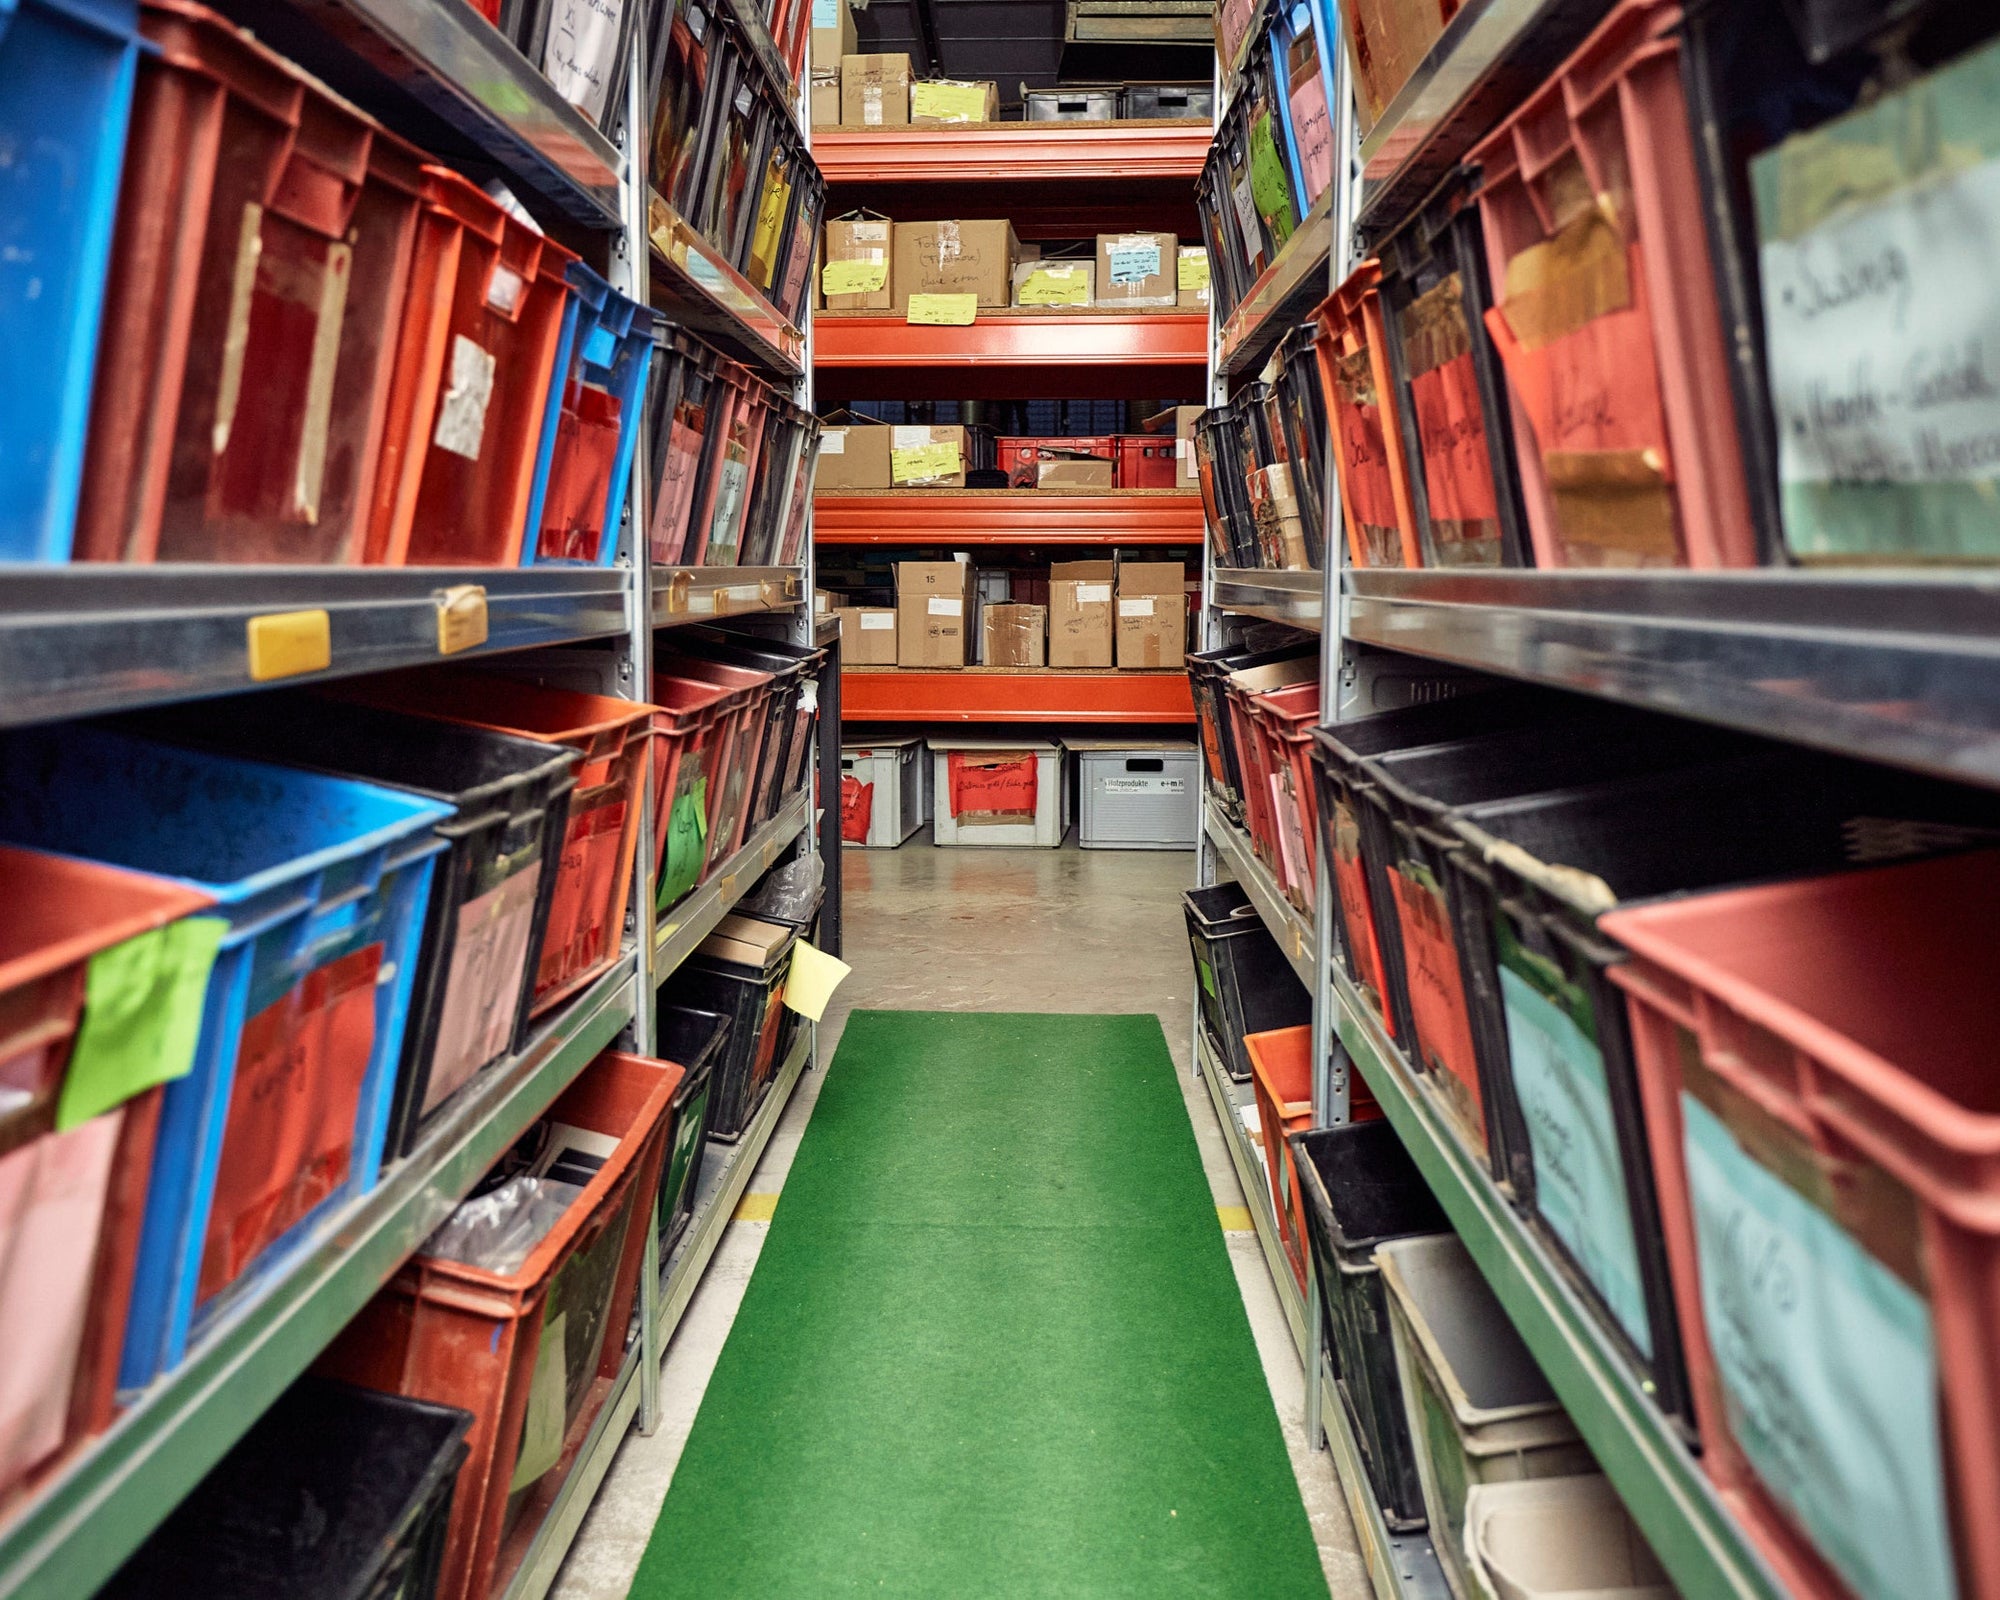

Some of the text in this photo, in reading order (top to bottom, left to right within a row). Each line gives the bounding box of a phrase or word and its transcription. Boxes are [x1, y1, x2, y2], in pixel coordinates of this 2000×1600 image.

[925, 575, 936, 584] 15
[1108, 779, 1149, 788] Holzprodukte
[1160, 780, 1178, 788] e+m
